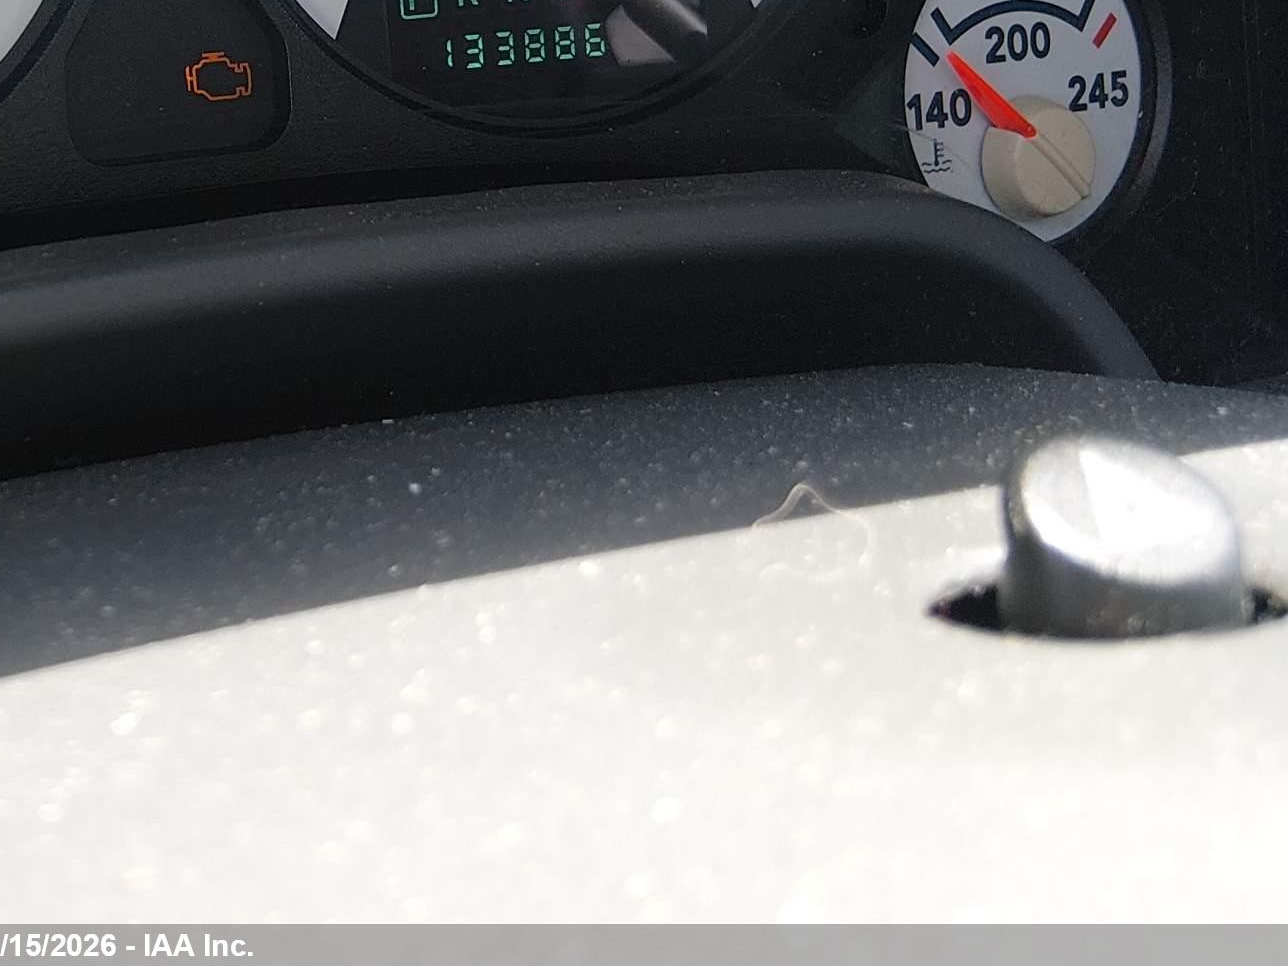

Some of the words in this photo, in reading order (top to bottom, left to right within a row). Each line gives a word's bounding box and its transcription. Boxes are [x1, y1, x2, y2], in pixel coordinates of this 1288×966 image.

[446, 23, 606, 69] 133886
[984, 21, 1051, 64] 200
[906, 88, 972, 131] 140
[1067, 70, 1129, 113] 245
